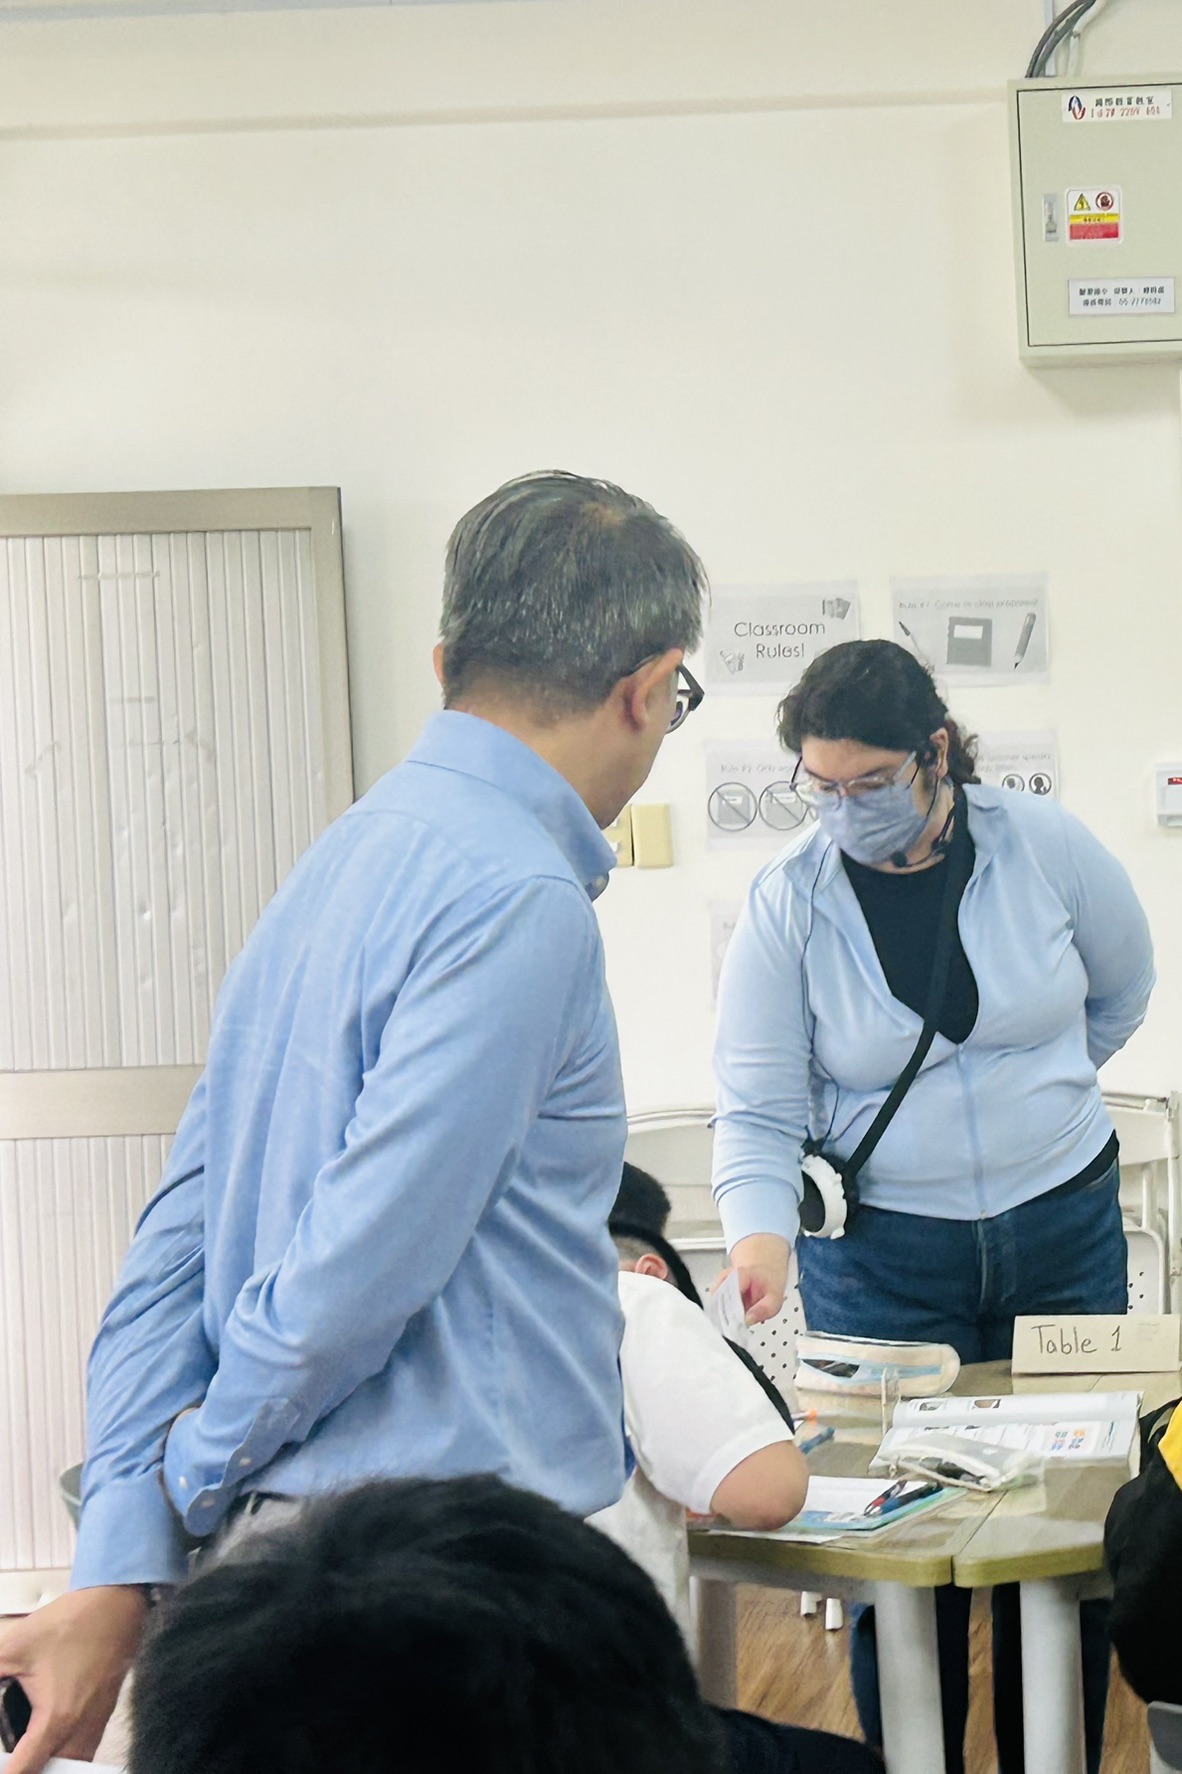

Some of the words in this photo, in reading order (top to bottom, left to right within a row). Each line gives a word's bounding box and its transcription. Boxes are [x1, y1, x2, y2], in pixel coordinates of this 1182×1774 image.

[734, 622, 825, 637] Classroom
[1031, 1324, 1097, 1354] Table
[1111, 1325, 1122, 1352] 1
